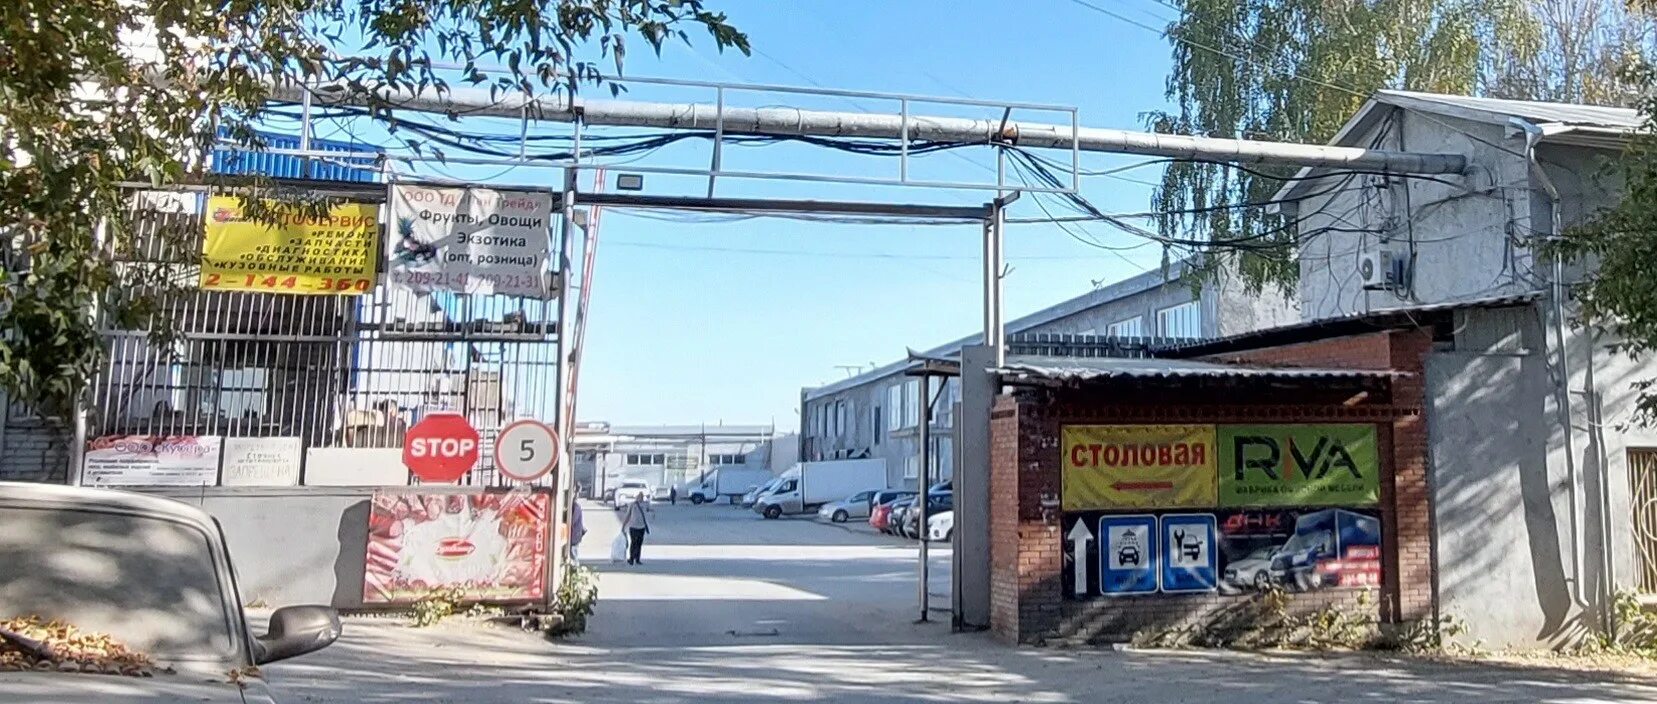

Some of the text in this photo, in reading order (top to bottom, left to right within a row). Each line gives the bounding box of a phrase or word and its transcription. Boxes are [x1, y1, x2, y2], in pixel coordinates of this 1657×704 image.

[258, 211, 376, 229] ТОСЕРВИС
[419, 208, 542, 230] Фрукты, Овощи
[294, 239, 373, 248] ЗАПЧАСТИ
[456, 231, 527, 248] Экзотика
[245, 253, 367, 266] ОБСЛУЖИВАНИЕ
[260, 245, 369, 257] ДИАГНОСТИКА
[443, 250, 538, 267] (опт, розница)
[218, 262, 365, 275] КУЗОВНЫЕ РАБОТЫ
[410, 438, 475, 458] STOP
[519, 439, 535, 462] 5
